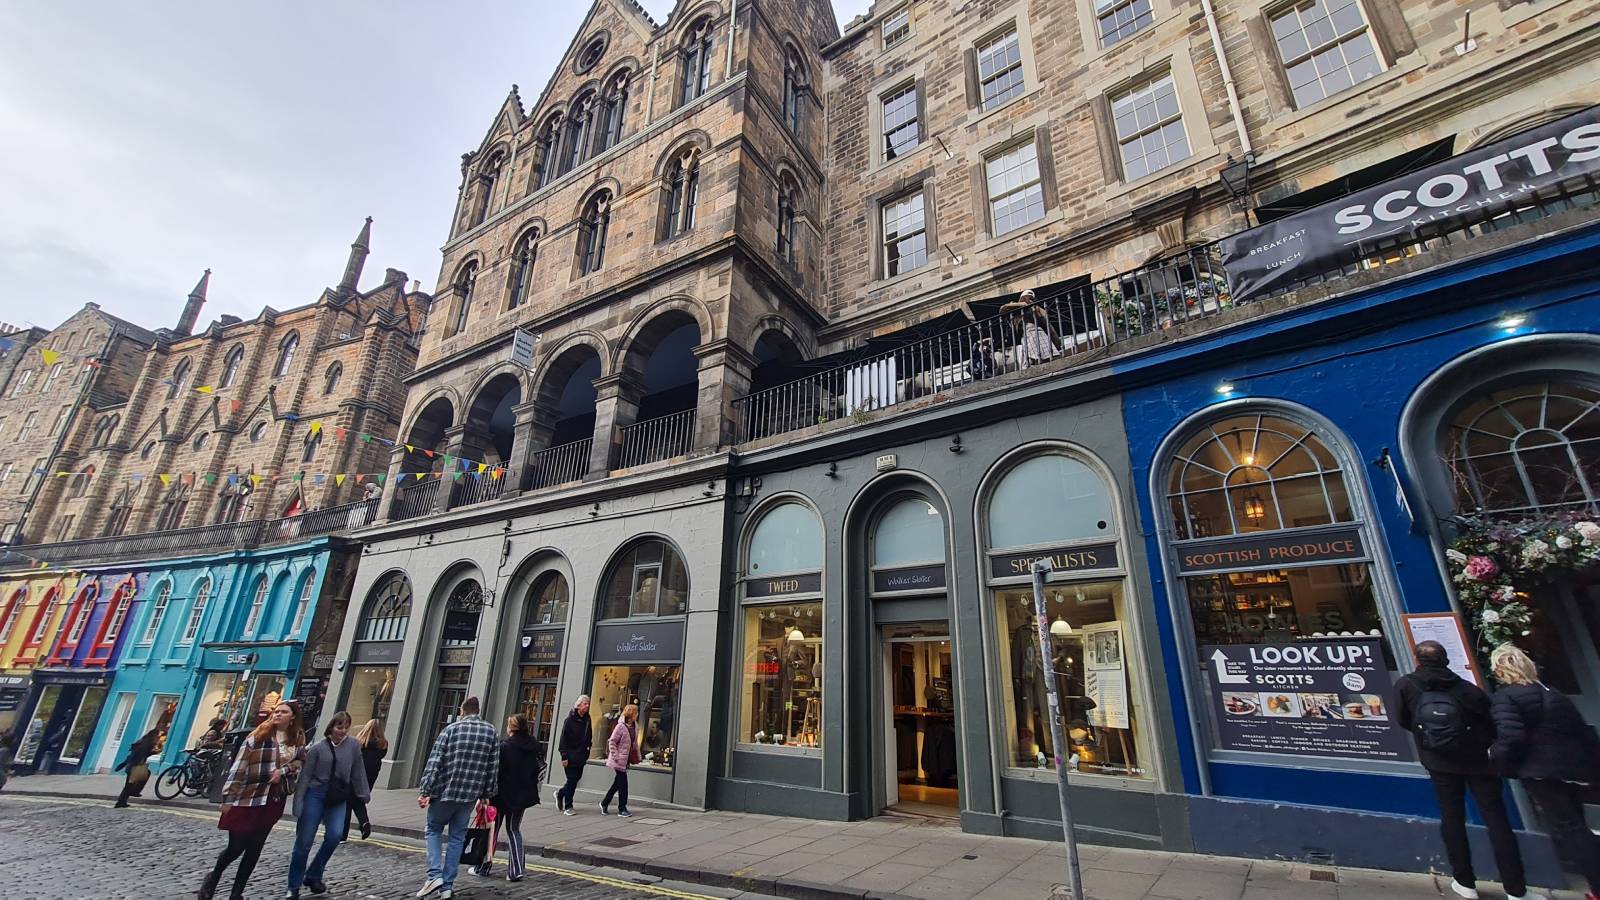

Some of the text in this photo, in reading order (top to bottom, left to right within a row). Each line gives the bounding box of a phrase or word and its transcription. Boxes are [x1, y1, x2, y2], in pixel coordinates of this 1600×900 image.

[1334, 122, 1600, 235] SCOTTS
[1411, 183, 1536, 228] KITCHEN
[1250, 229, 1307, 257] BREAKFAST
[1265, 251, 1302, 270] LUNCH
[1010, 551, 1097, 573] SPEALISTS
[1185, 540, 1355, 567] SCOTTISH PRODUCE
[768, 579, 799, 593] TWEED
[887, 574, 932, 587] Walker Slater
[616, 641, 657, 652] Walker Slater
[1250, 645, 1373, 664] LOOK UP!
[227, 654, 248, 664] SWIS
[1255, 674, 1315, 685] SCOTTS
